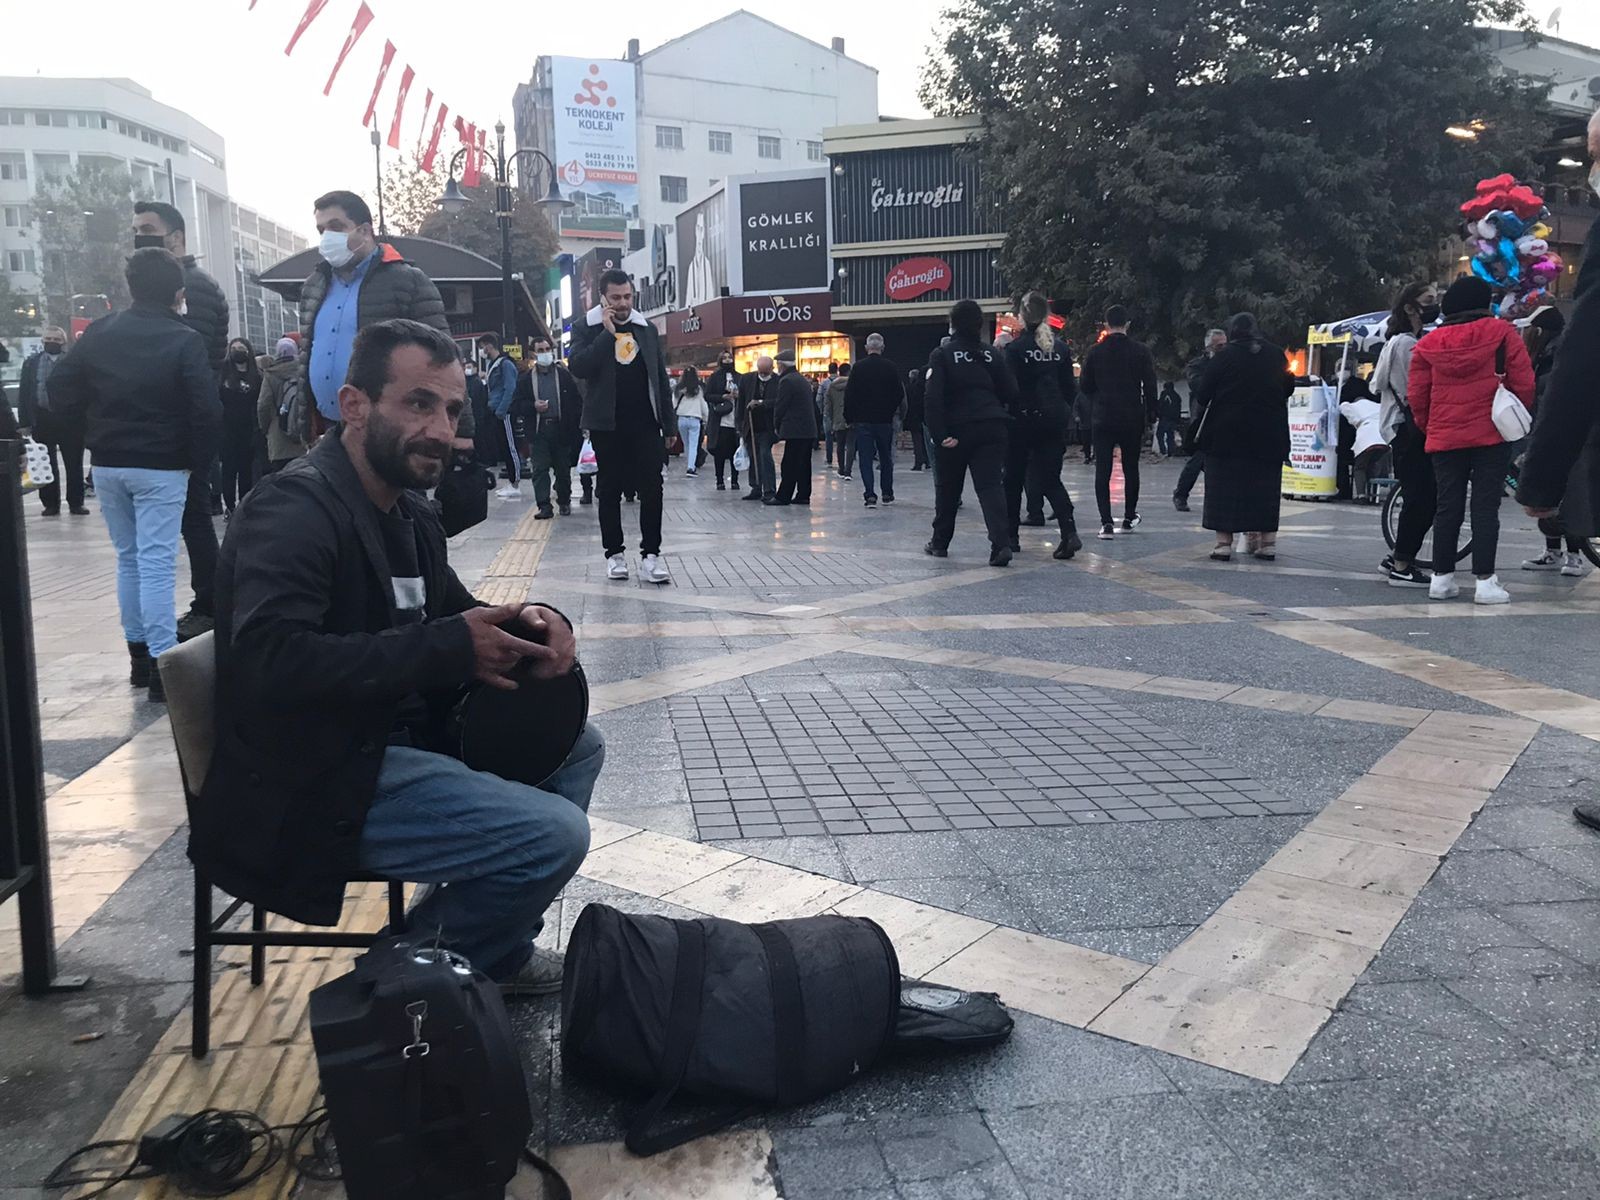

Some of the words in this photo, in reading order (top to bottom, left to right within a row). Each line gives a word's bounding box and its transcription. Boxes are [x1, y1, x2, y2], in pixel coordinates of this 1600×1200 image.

[565, 107, 625, 121] TEKNOKENT
[579, 120, 613, 131] KOLEJİ
[568, 159, 578, 175] 4
[748, 211, 814, 228] GÖMLEK
[749, 233, 821, 252] KRALLIĞI
[743, 305, 812, 323] TUDORS
[681, 316, 700, 333] TUDORS
[953, 350, 993, 363] POS
